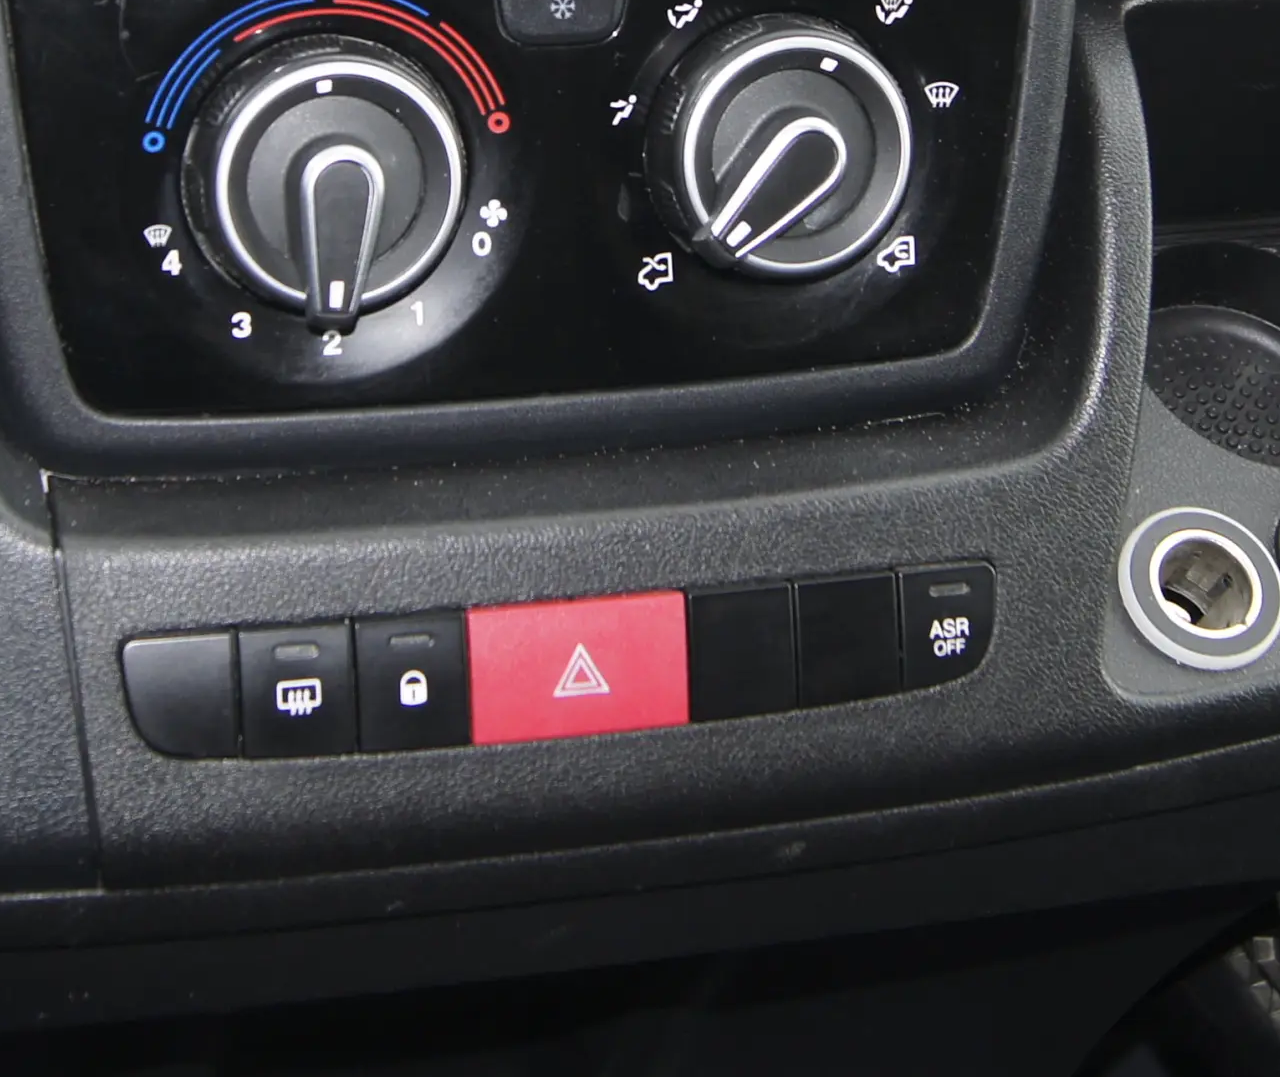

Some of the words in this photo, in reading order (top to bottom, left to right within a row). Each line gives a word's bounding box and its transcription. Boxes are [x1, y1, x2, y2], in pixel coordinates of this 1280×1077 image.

[161, 249, 183, 276] 4
[231, 311, 253, 339] 3
[410, 300, 425, 327] 1
[322, 330, 343, 356] 2
[929, 616, 970, 640] ASR
[933, 637, 966, 657] OFF
